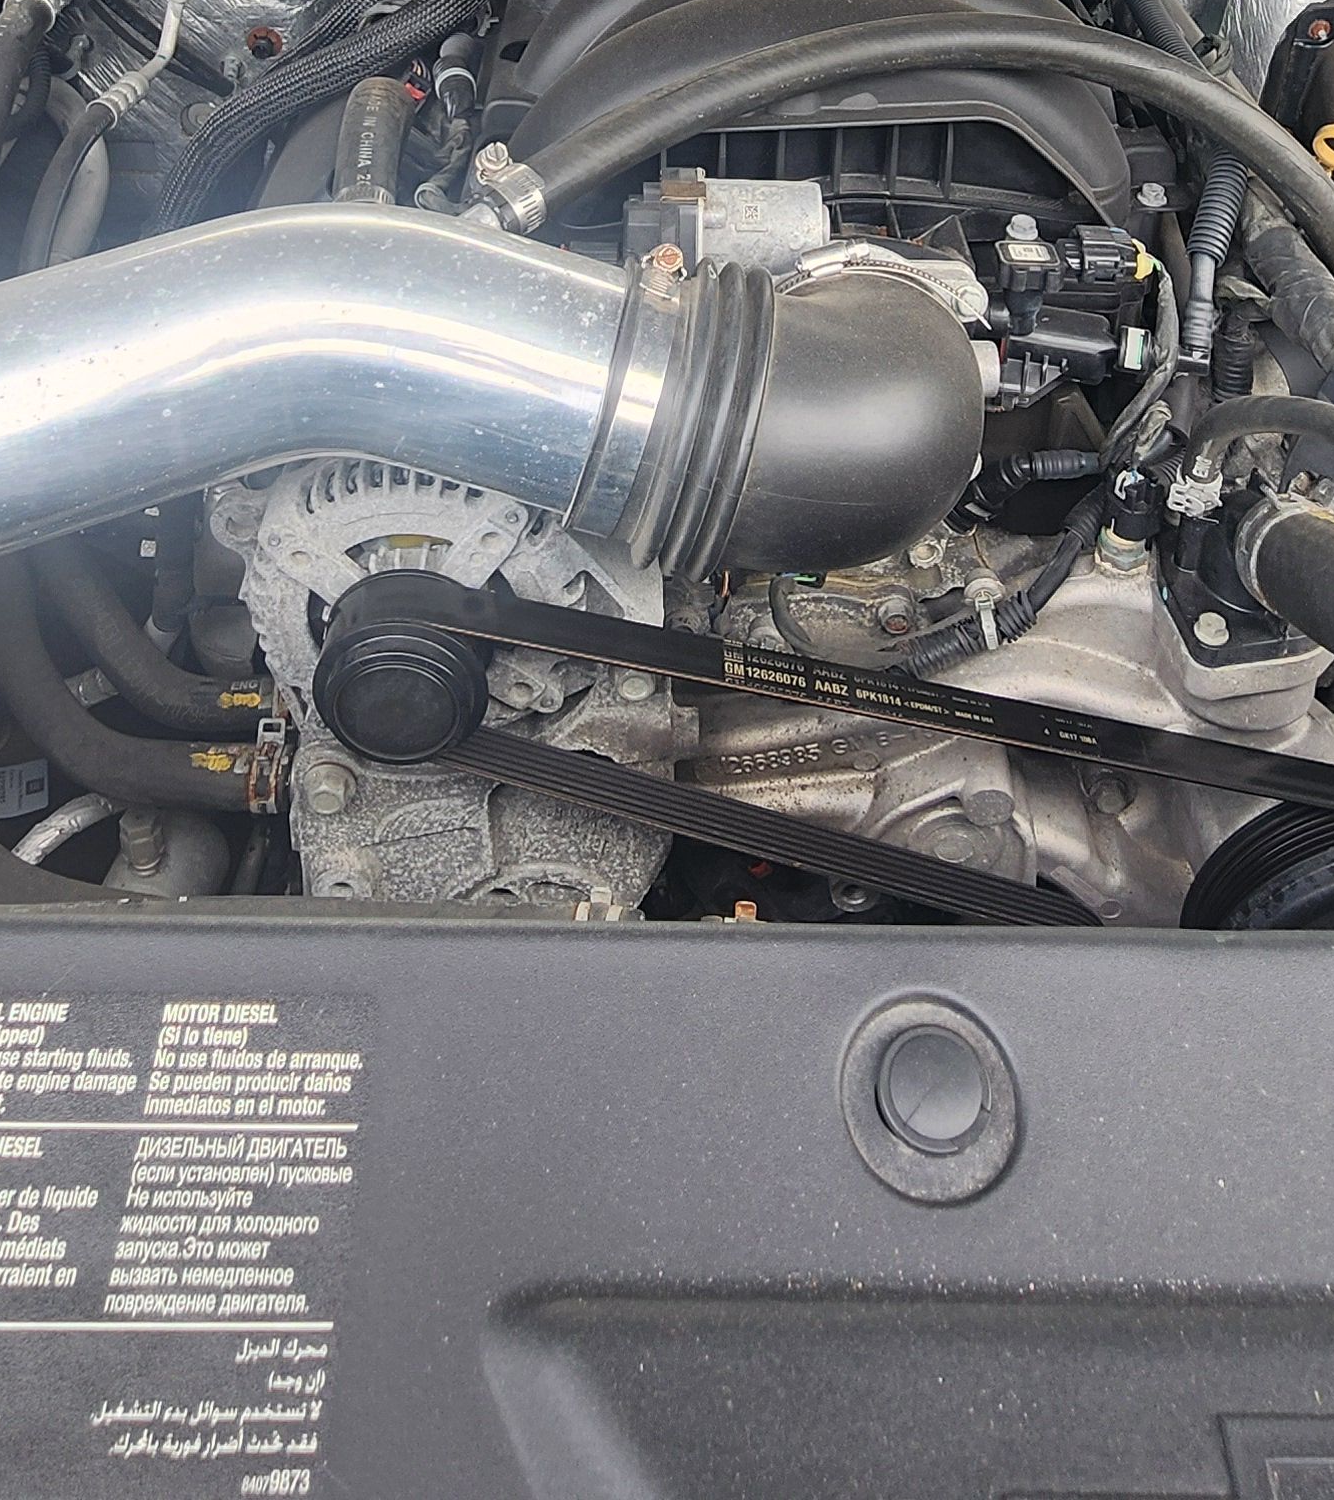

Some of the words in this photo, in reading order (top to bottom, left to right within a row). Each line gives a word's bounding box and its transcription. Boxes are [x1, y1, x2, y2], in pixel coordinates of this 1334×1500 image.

[362, 116, 377, 127] IN
[357, 132, 375, 168] CHINA
[230, 680, 258, 691] ENG
[724, 661, 745, 677] GM
[745, 662, 806, 688] 12626076
[814, 678, 849, 698] AABZ
[7, 1003, 69, 1022] ENGINE
[162, 1003, 220, 1023] MOTOR
[223, 1004, 278, 1024] DIESEL
[158, 1025, 182, 1048] (Si
[183, 1027, 199, 1046] lo
[203, 1026, 249, 1049] tiene)
[21, 1048, 84, 1072] starting
[86, 1048, 133, 1068] fluids.
[153, 1048, 175, 1068] No
[178, 1051, 207, 1069] use
[210, 1049, 263, 1069] fluidos
[267, 1049, 287, 1069] de
[289, 1051, 364, 1073] arranque.
[16, 1071, 71, 1095] engine
[73, 1071, 138, 1096] damage
[148, 1071, 171, 1092] Se
[171, 1071, 231, 1095] pueden
[234, 1072, 301, 1095] producir
[304, 1073, 352, 1092] daños
[234, 1098, 256, 1116] en
[258, 1096, 275, 1116] el
[277, 1097, 326, 1116] motor.
[134, 1133, 246, 1160] ДИЗЕЛЬНЫЙ
[246, 1136, 349, 1161] ДВИГАТЕЛЬ
[131, 1161, 175, 1186] (если
[176, 1162, 276, 1188] установлен)
[277, 1164, 354, 1188] пусковые
[18, 1185, 41, 1208] de
[42, 1185, 99, 1213] liquide
[125, 1185, 150, 1208] Не
[151, 1186, 254, 1213] используйте
[7, 1211, 41, 1233] Des
[120, 1214, 198, 1237] жидкости
[198, 1215, 232, 1236] для
[233, 1214, 320, 1237] холодного
[216, 1240, 271, 1260] может
[54, 1267, 78, 1287] en
[109, 1266, 178, 1287] вызвать
[180, 1266, 295, 1290] немедленное
[104, 1291, 217, 1318] повреждение
[218, 1292, 310, 1317] двигателя.
[234, 1338, 281, 1364] الديزل
[282, 1338, 328, 1363] محرك
[188, 1400, 238, 1426] سوائل
[239, 1401, 308, 1425] تستخدم
[309, 1399, 323, 1422] لا
[286, 1431, 318, 1454] فقد
[241, 1468, 310, 1495] 84079873
